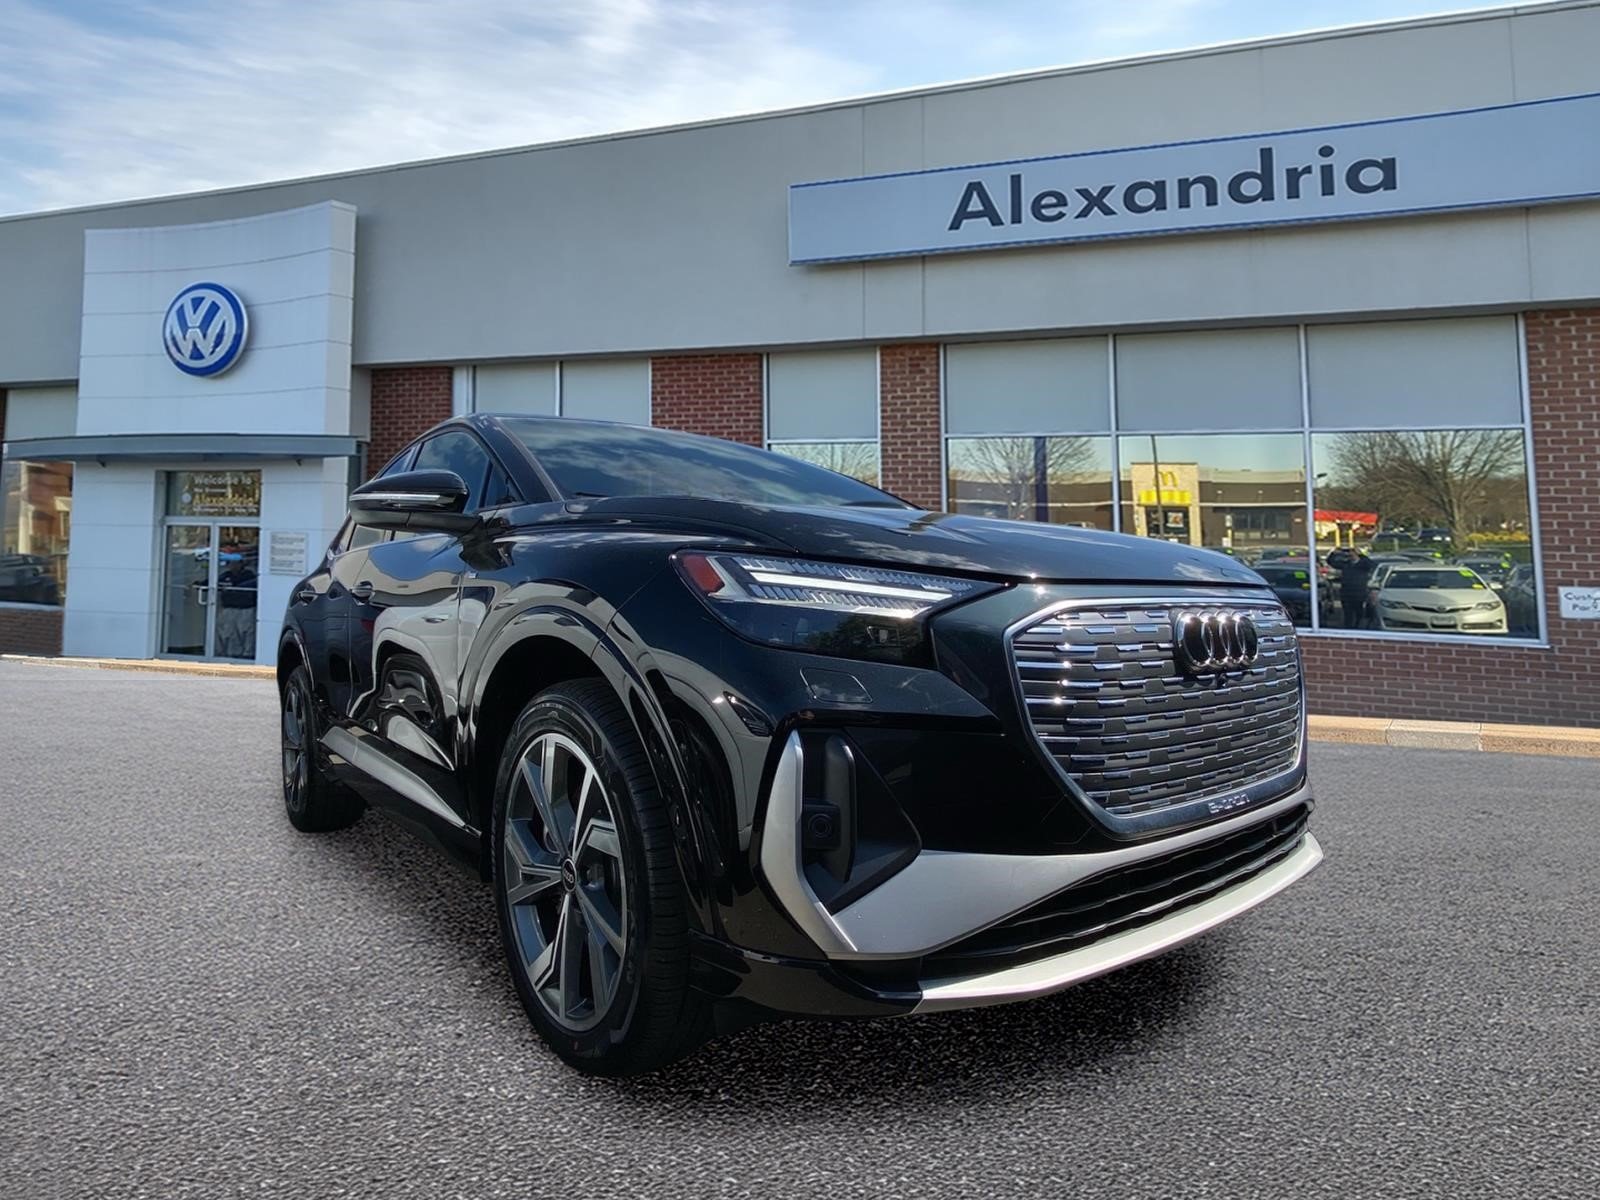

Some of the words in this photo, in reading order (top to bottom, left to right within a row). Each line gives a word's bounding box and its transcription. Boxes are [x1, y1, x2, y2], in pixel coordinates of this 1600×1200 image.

[947, 145, 1398, 231] Alexandria
[166, 285, 243, 372] VW
[194, 474, 239, 485] Welcome
